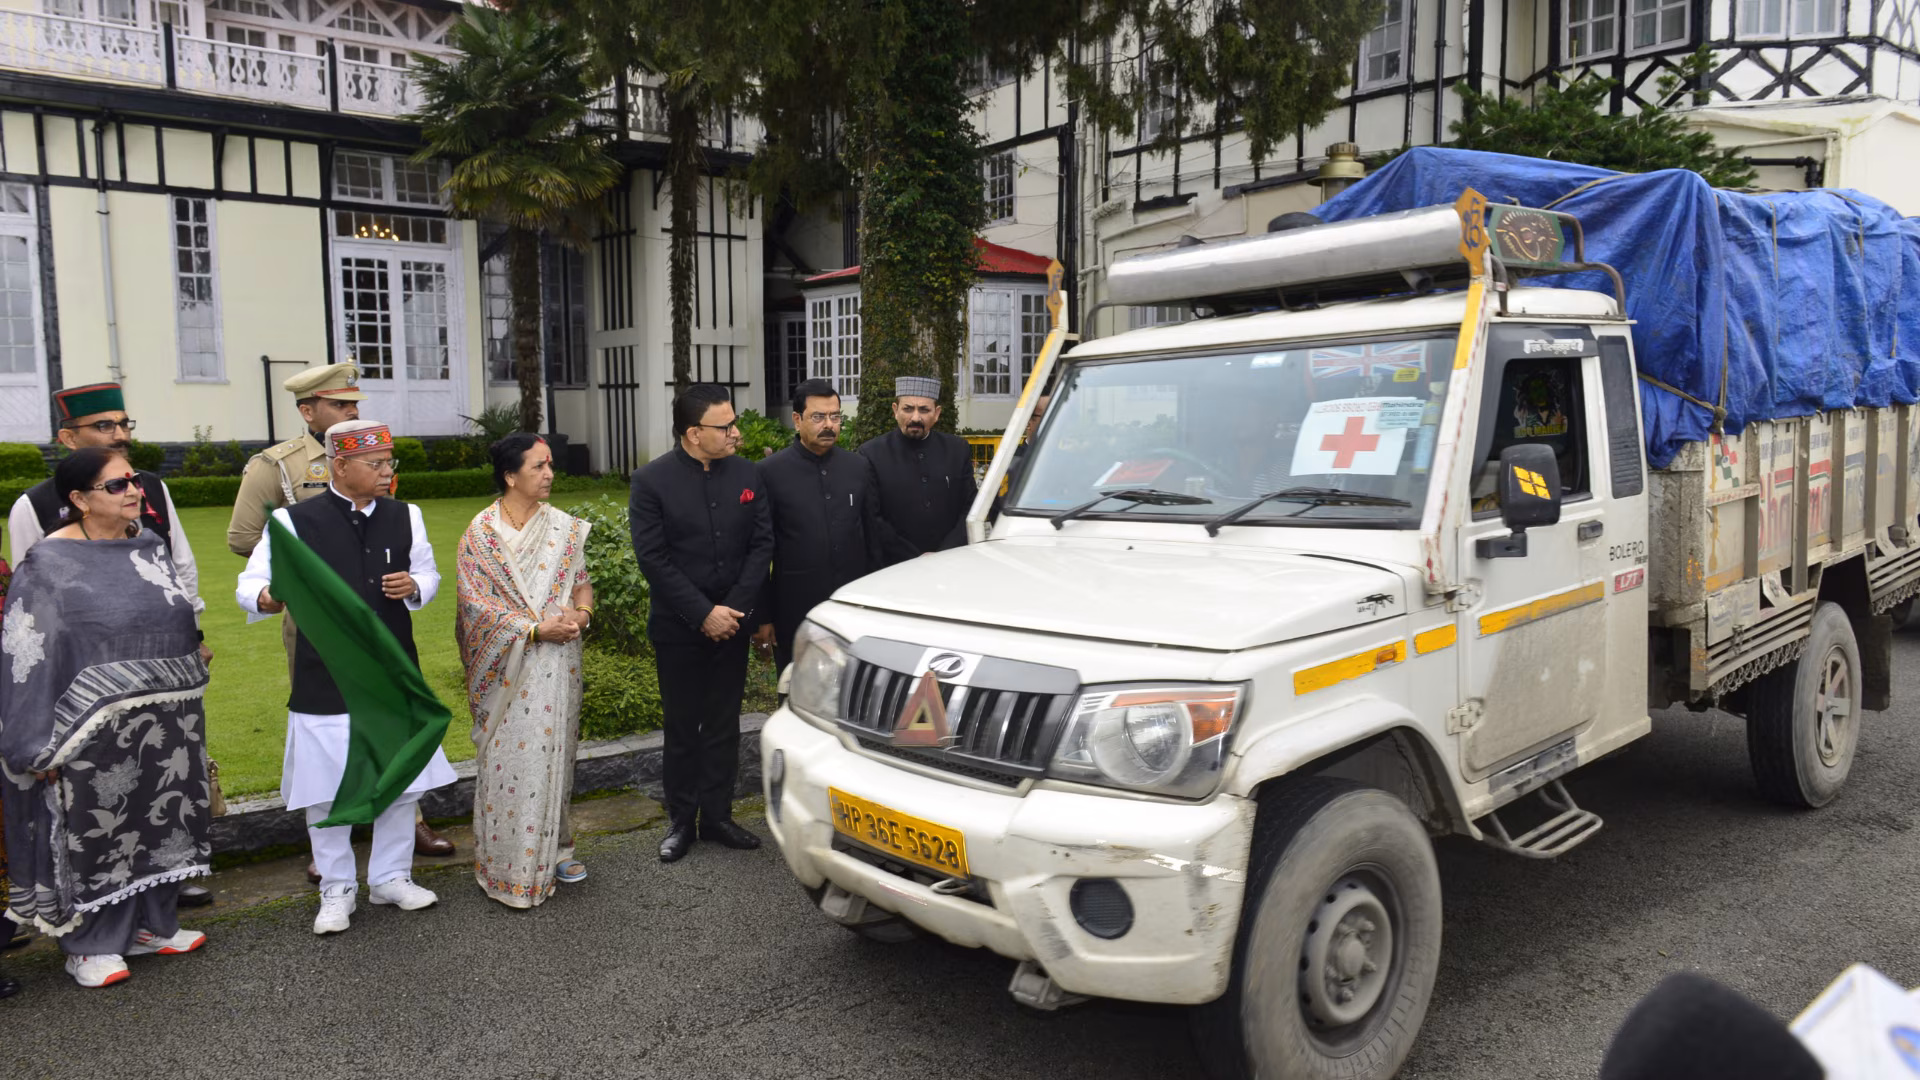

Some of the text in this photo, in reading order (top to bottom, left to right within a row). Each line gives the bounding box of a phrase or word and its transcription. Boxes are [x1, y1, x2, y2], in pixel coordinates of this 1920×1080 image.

[1609, 540, 1645, 561] BOLERO
[840, 799, 961, 869] HP 36E 5628
